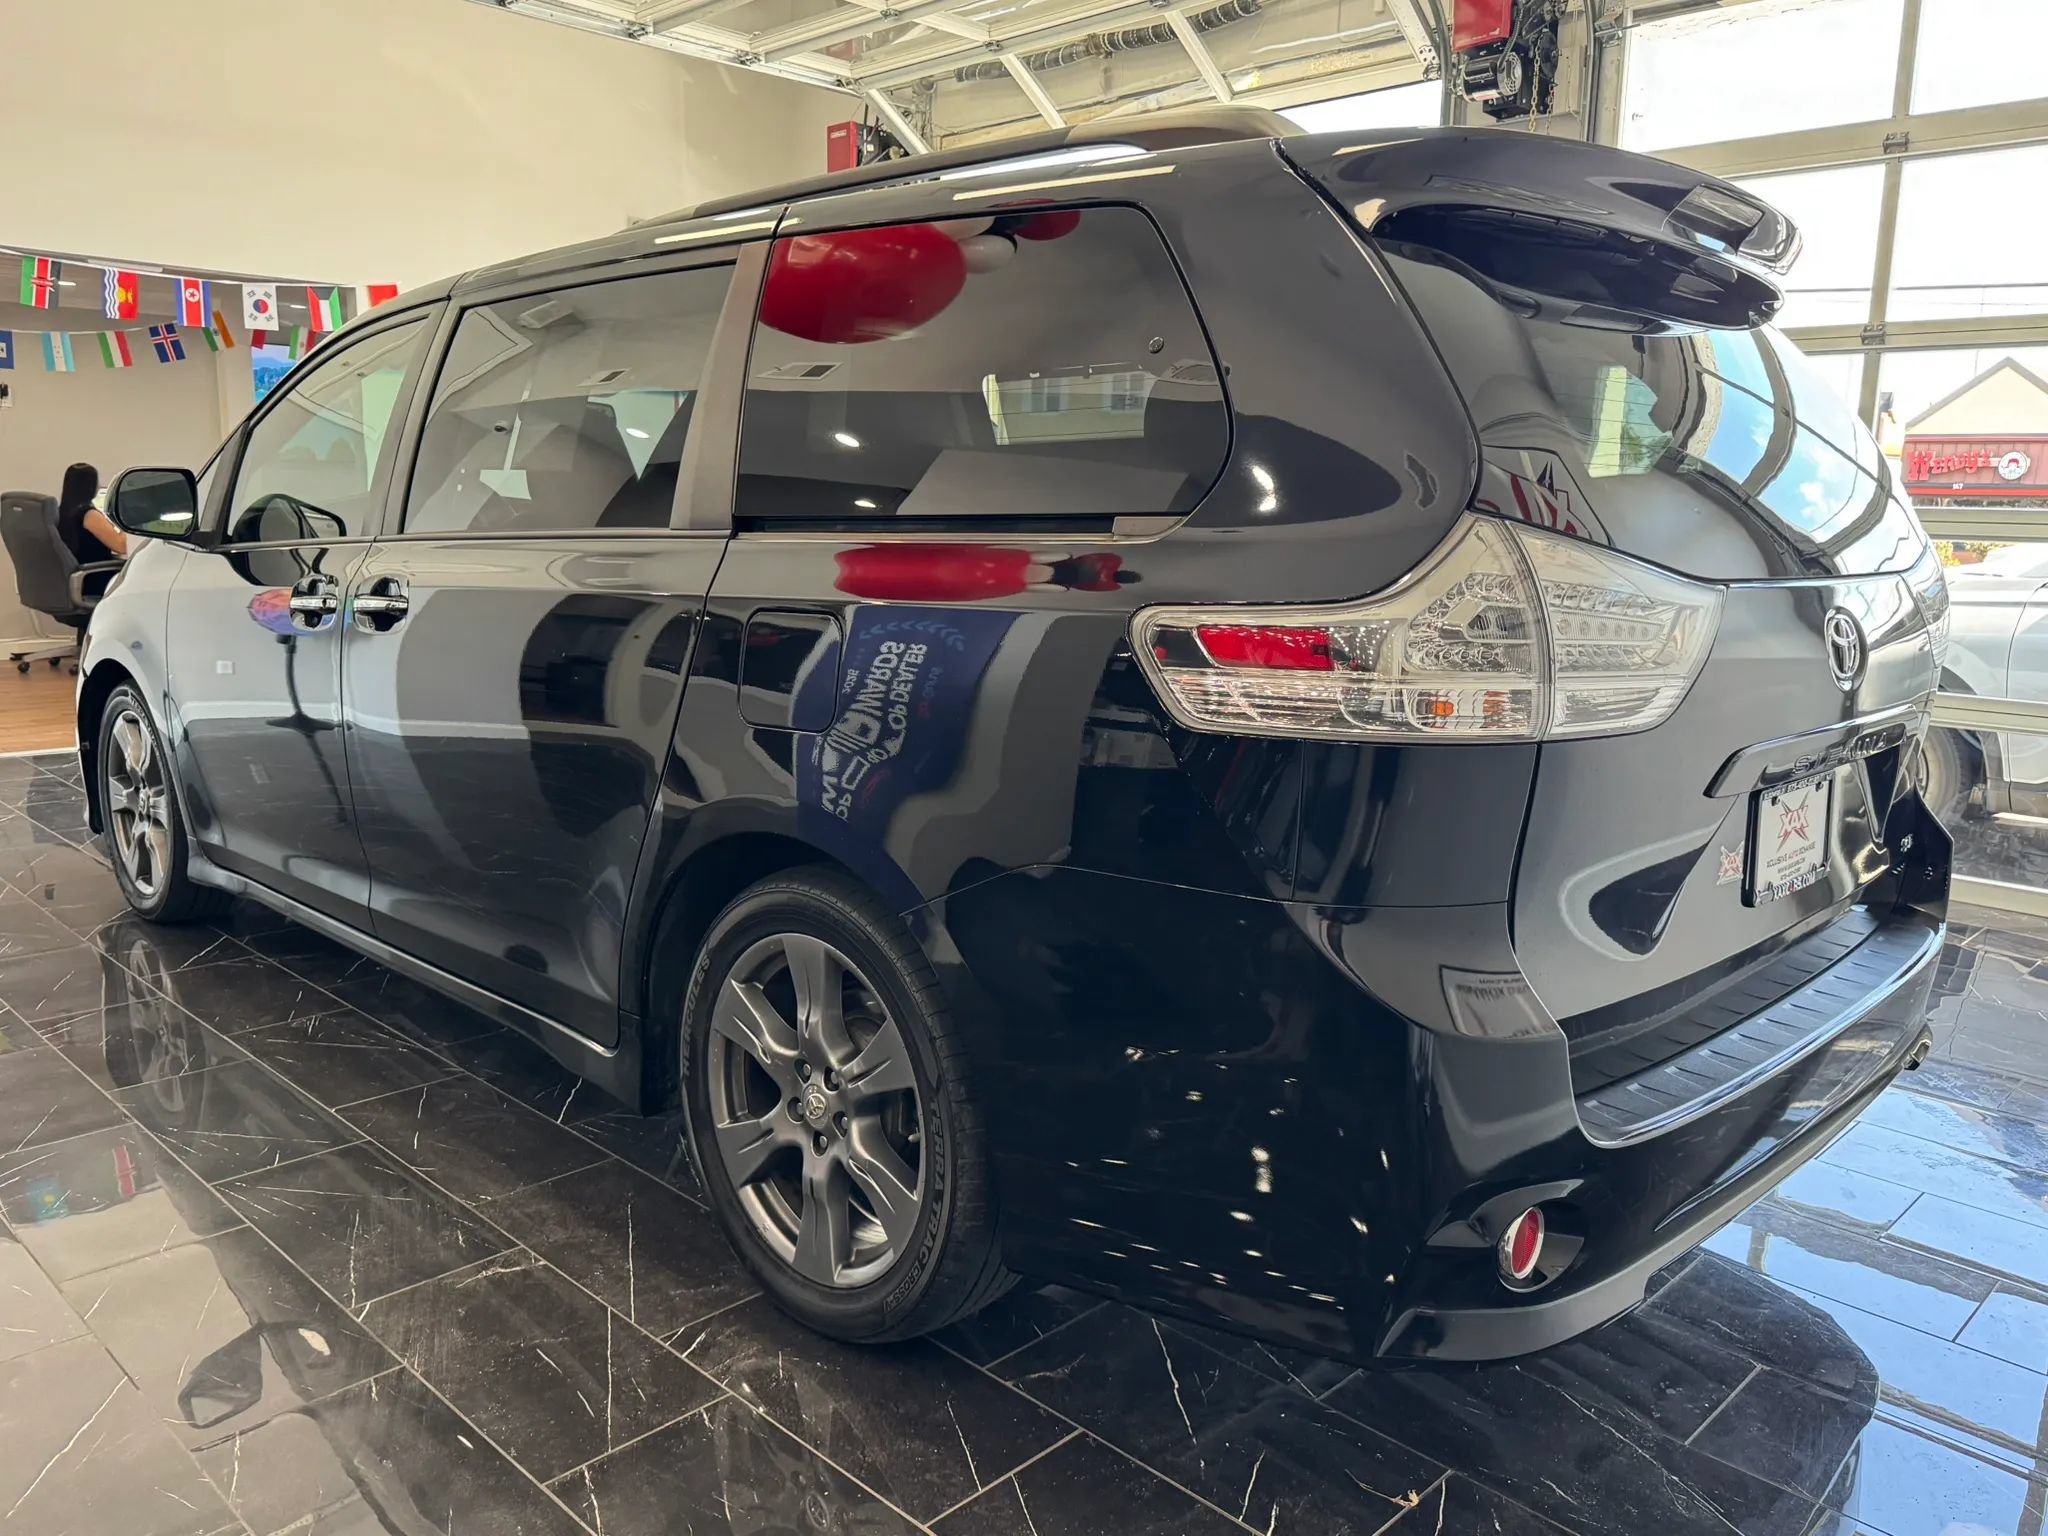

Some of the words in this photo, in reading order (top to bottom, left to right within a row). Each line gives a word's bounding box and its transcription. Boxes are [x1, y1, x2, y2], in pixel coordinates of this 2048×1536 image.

[1792, 732, 1889, 774] SIENNA
[683, 953, 710, 1078] HERCULES
[929, 1098, 945, 1191] TERRA
[919, 1200, 942, 1265] TRAC
